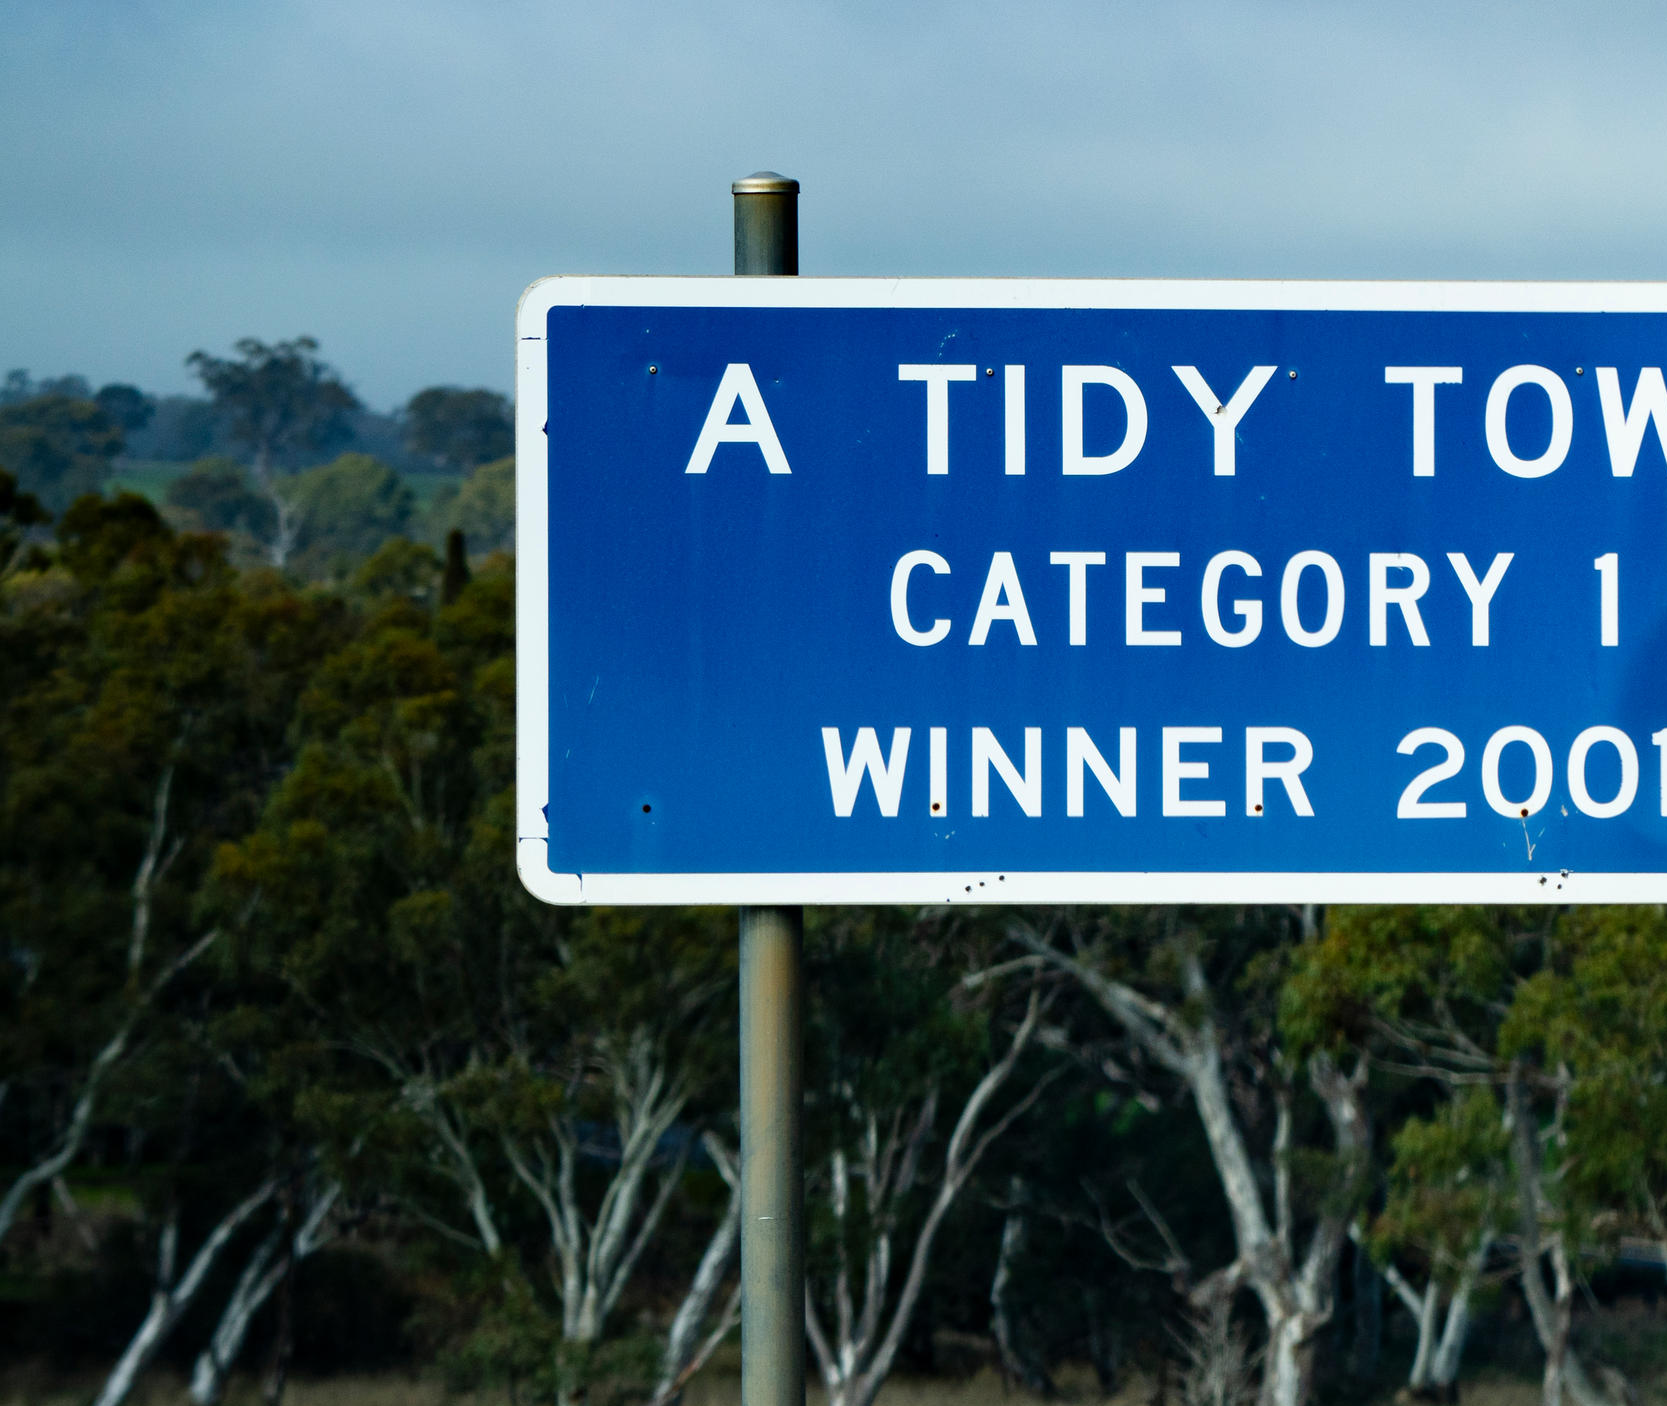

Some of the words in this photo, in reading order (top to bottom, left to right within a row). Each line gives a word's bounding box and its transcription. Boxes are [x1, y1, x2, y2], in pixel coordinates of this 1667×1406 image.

[686, 364, 792, 473] A
[899, 364, 1278, 475] TIDY
[890, 549, 1515, 647] CATEGORY
[1594, 552, 1619, 646] 1
[821, 726, 1314, 817] WINNER
